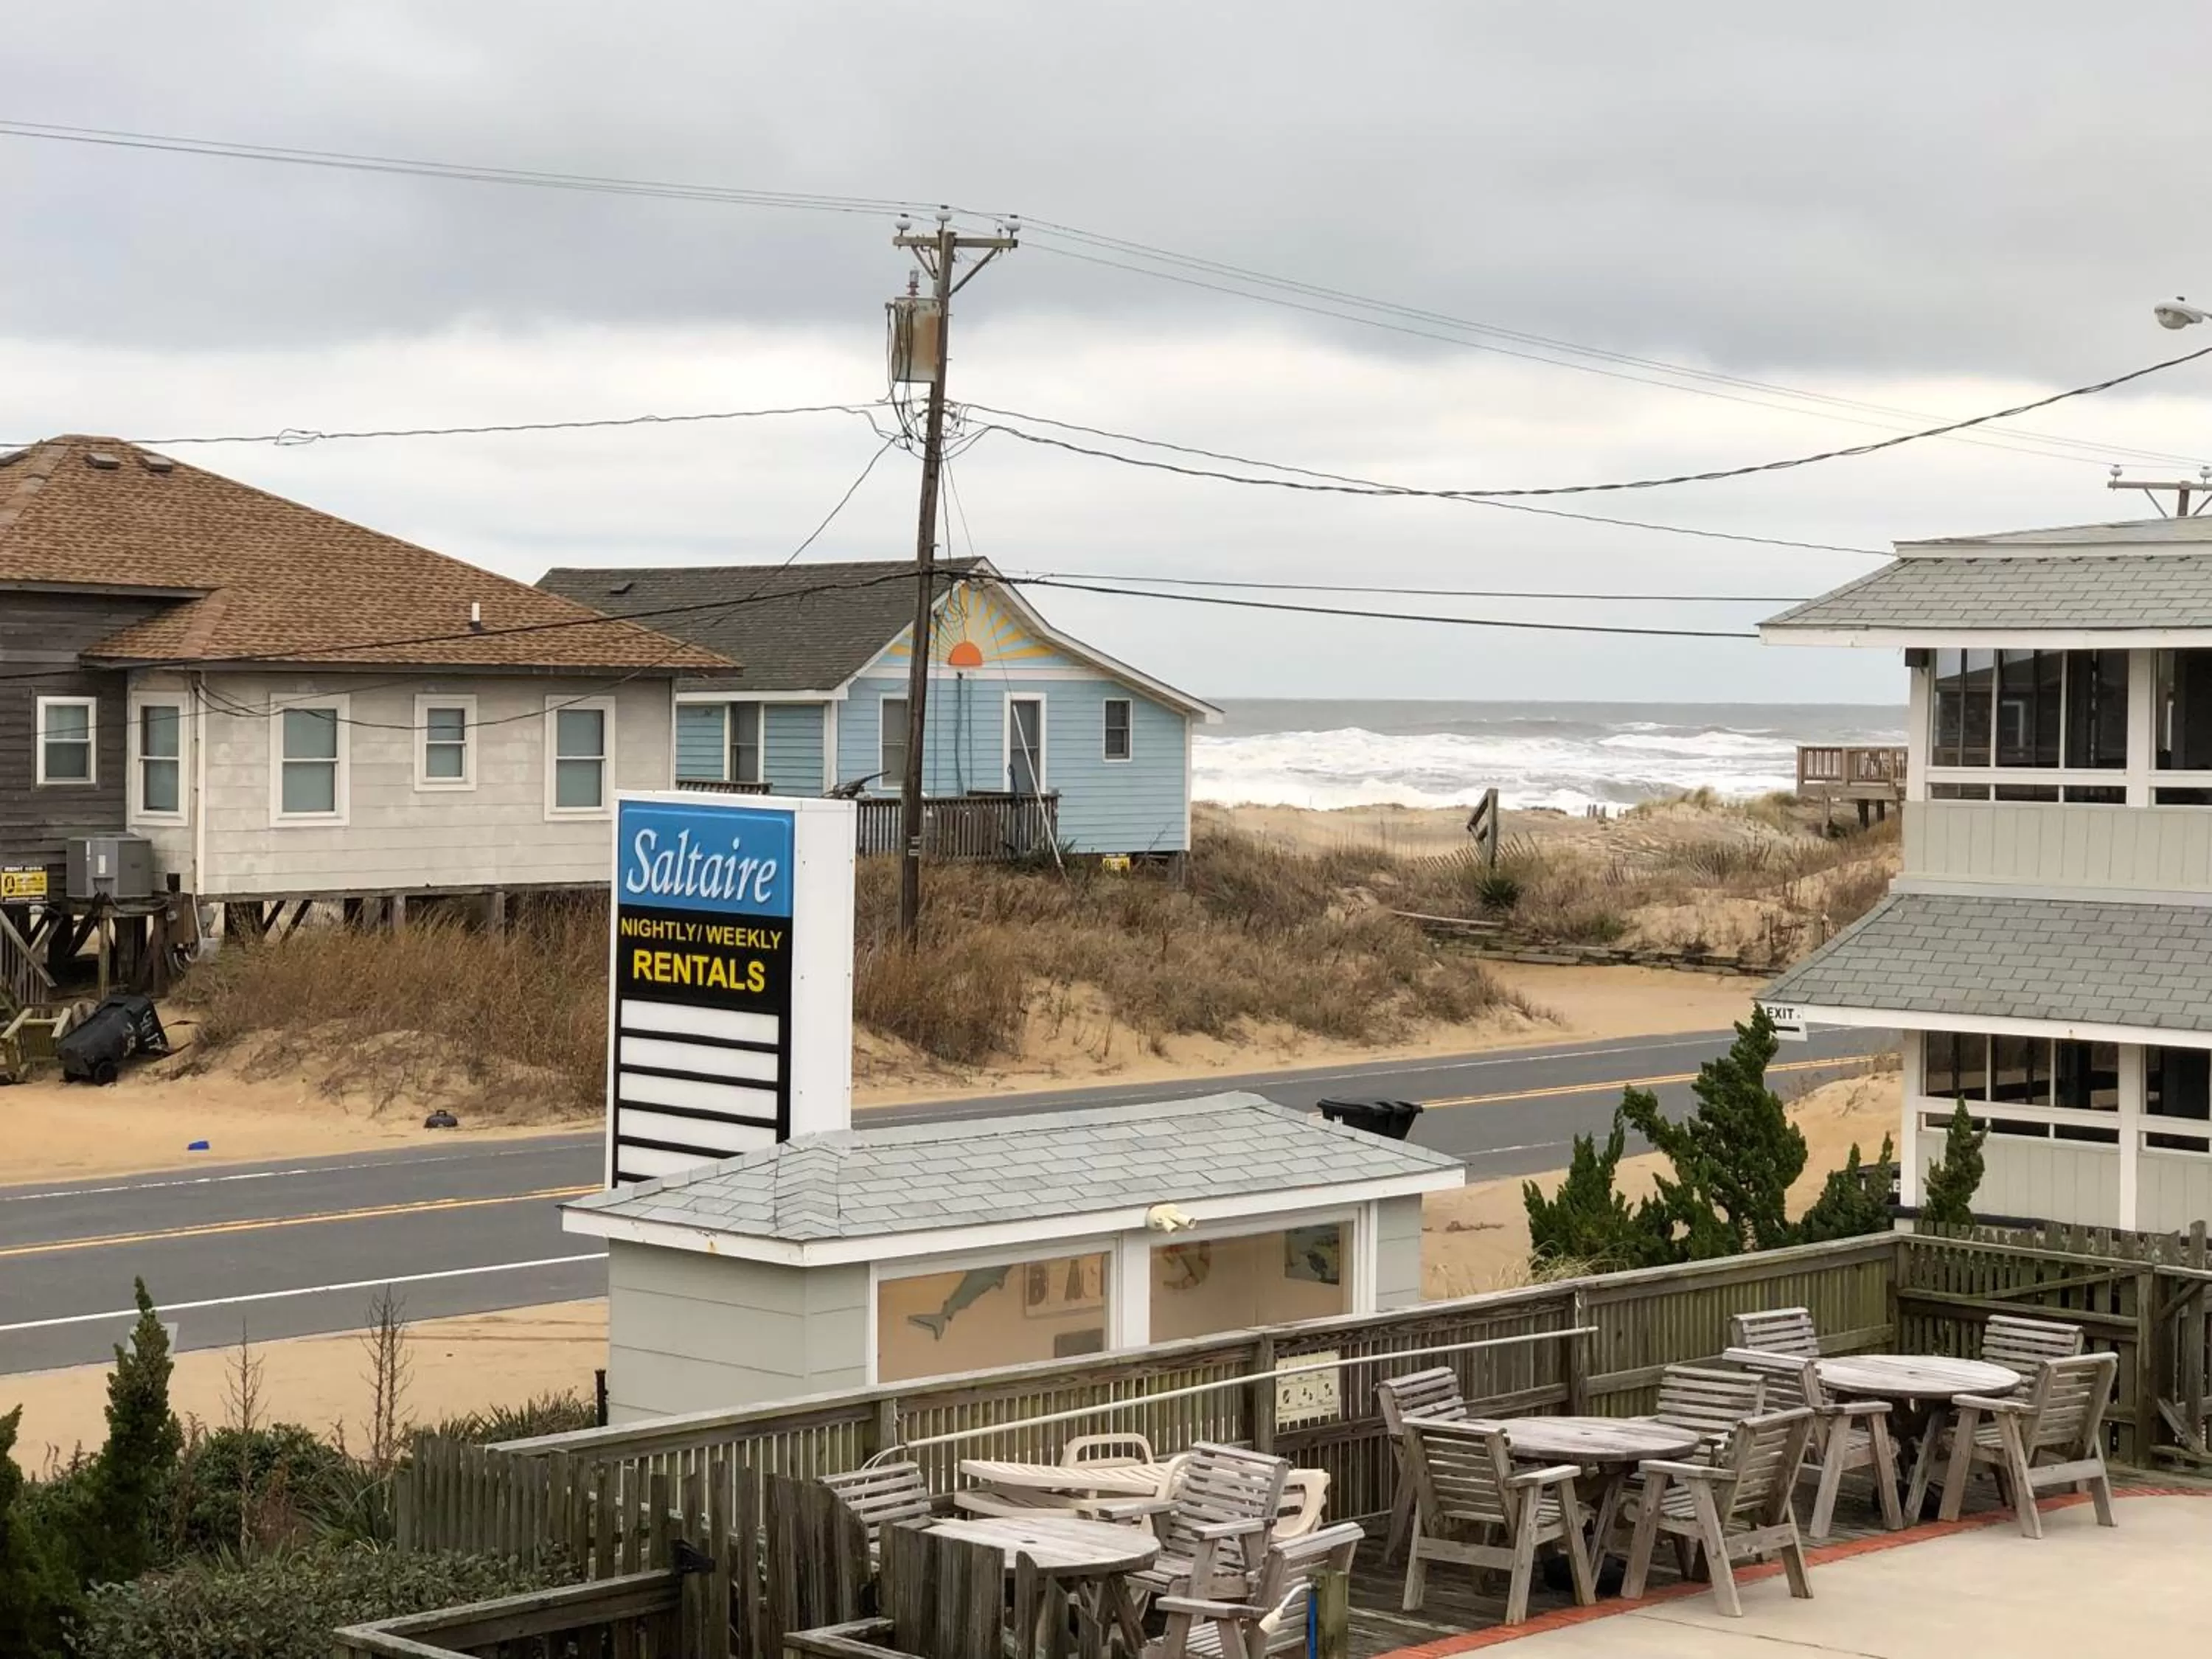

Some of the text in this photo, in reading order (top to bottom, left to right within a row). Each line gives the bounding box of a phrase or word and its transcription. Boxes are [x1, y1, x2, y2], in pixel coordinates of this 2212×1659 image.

[626, 828, 777, 904] Saltaire
[633, 948, 765, 992] RENTALS
[1767, 1006, 1794, 1019] EXIT
